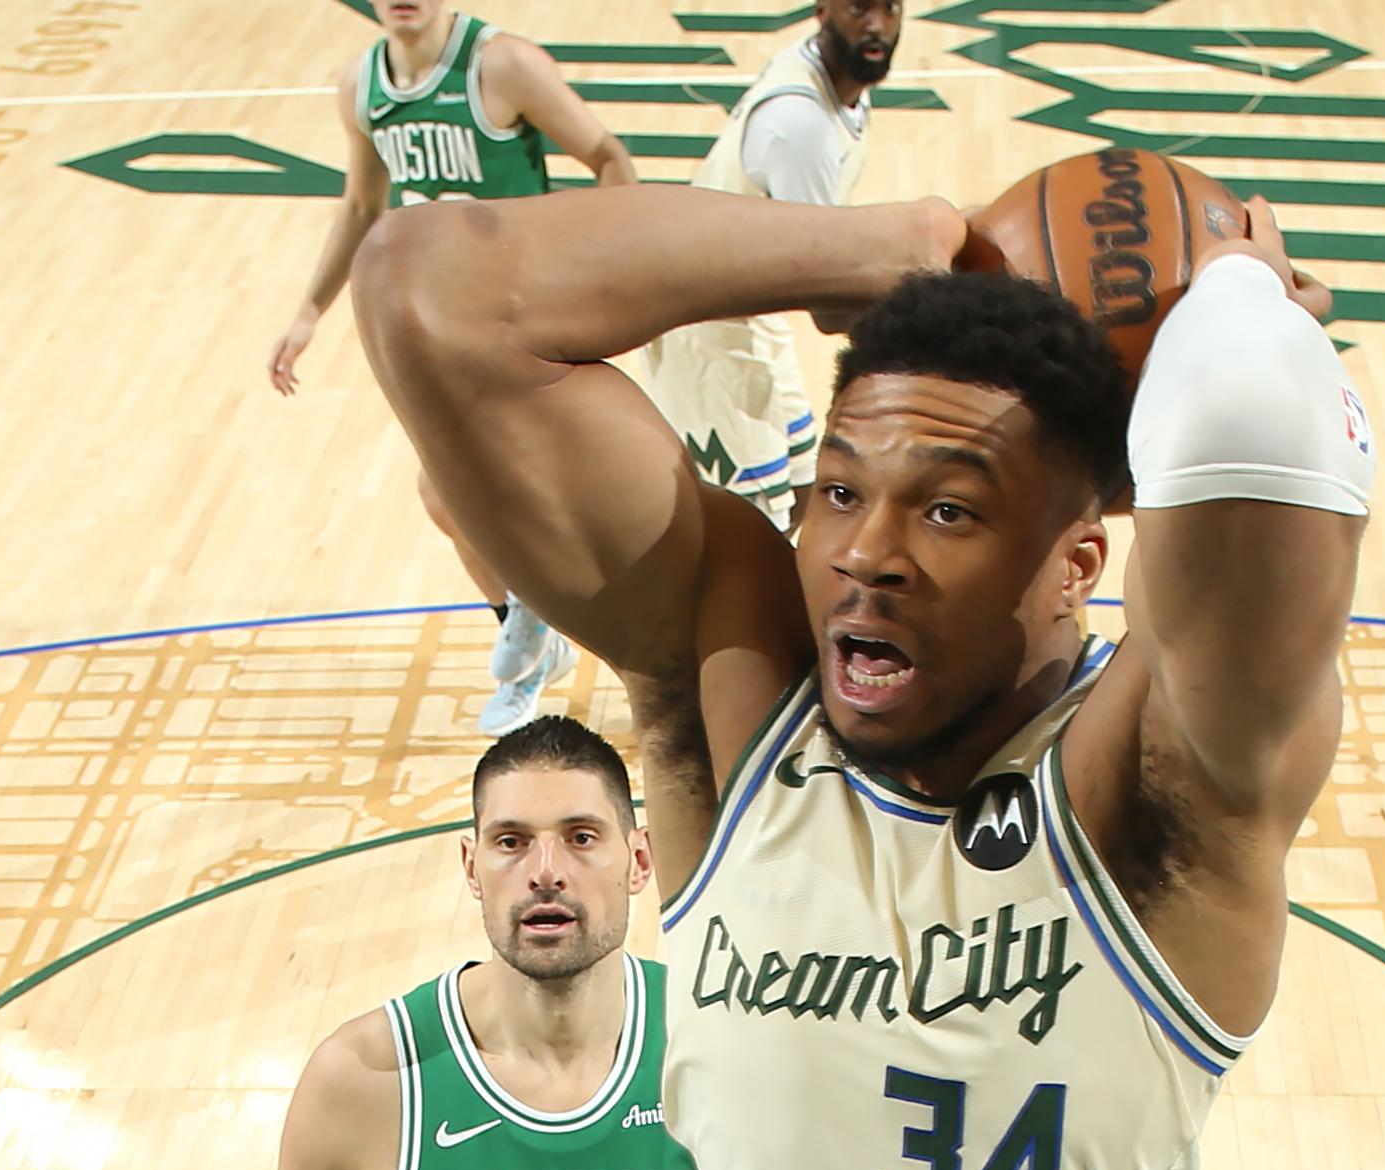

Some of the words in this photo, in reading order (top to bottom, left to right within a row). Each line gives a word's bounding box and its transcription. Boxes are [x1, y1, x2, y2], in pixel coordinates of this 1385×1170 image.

[692, 913, 901, 1024] Cream
[906, 902, 1085, 1045] City
[622, 1103, 664, 1129] Ami
